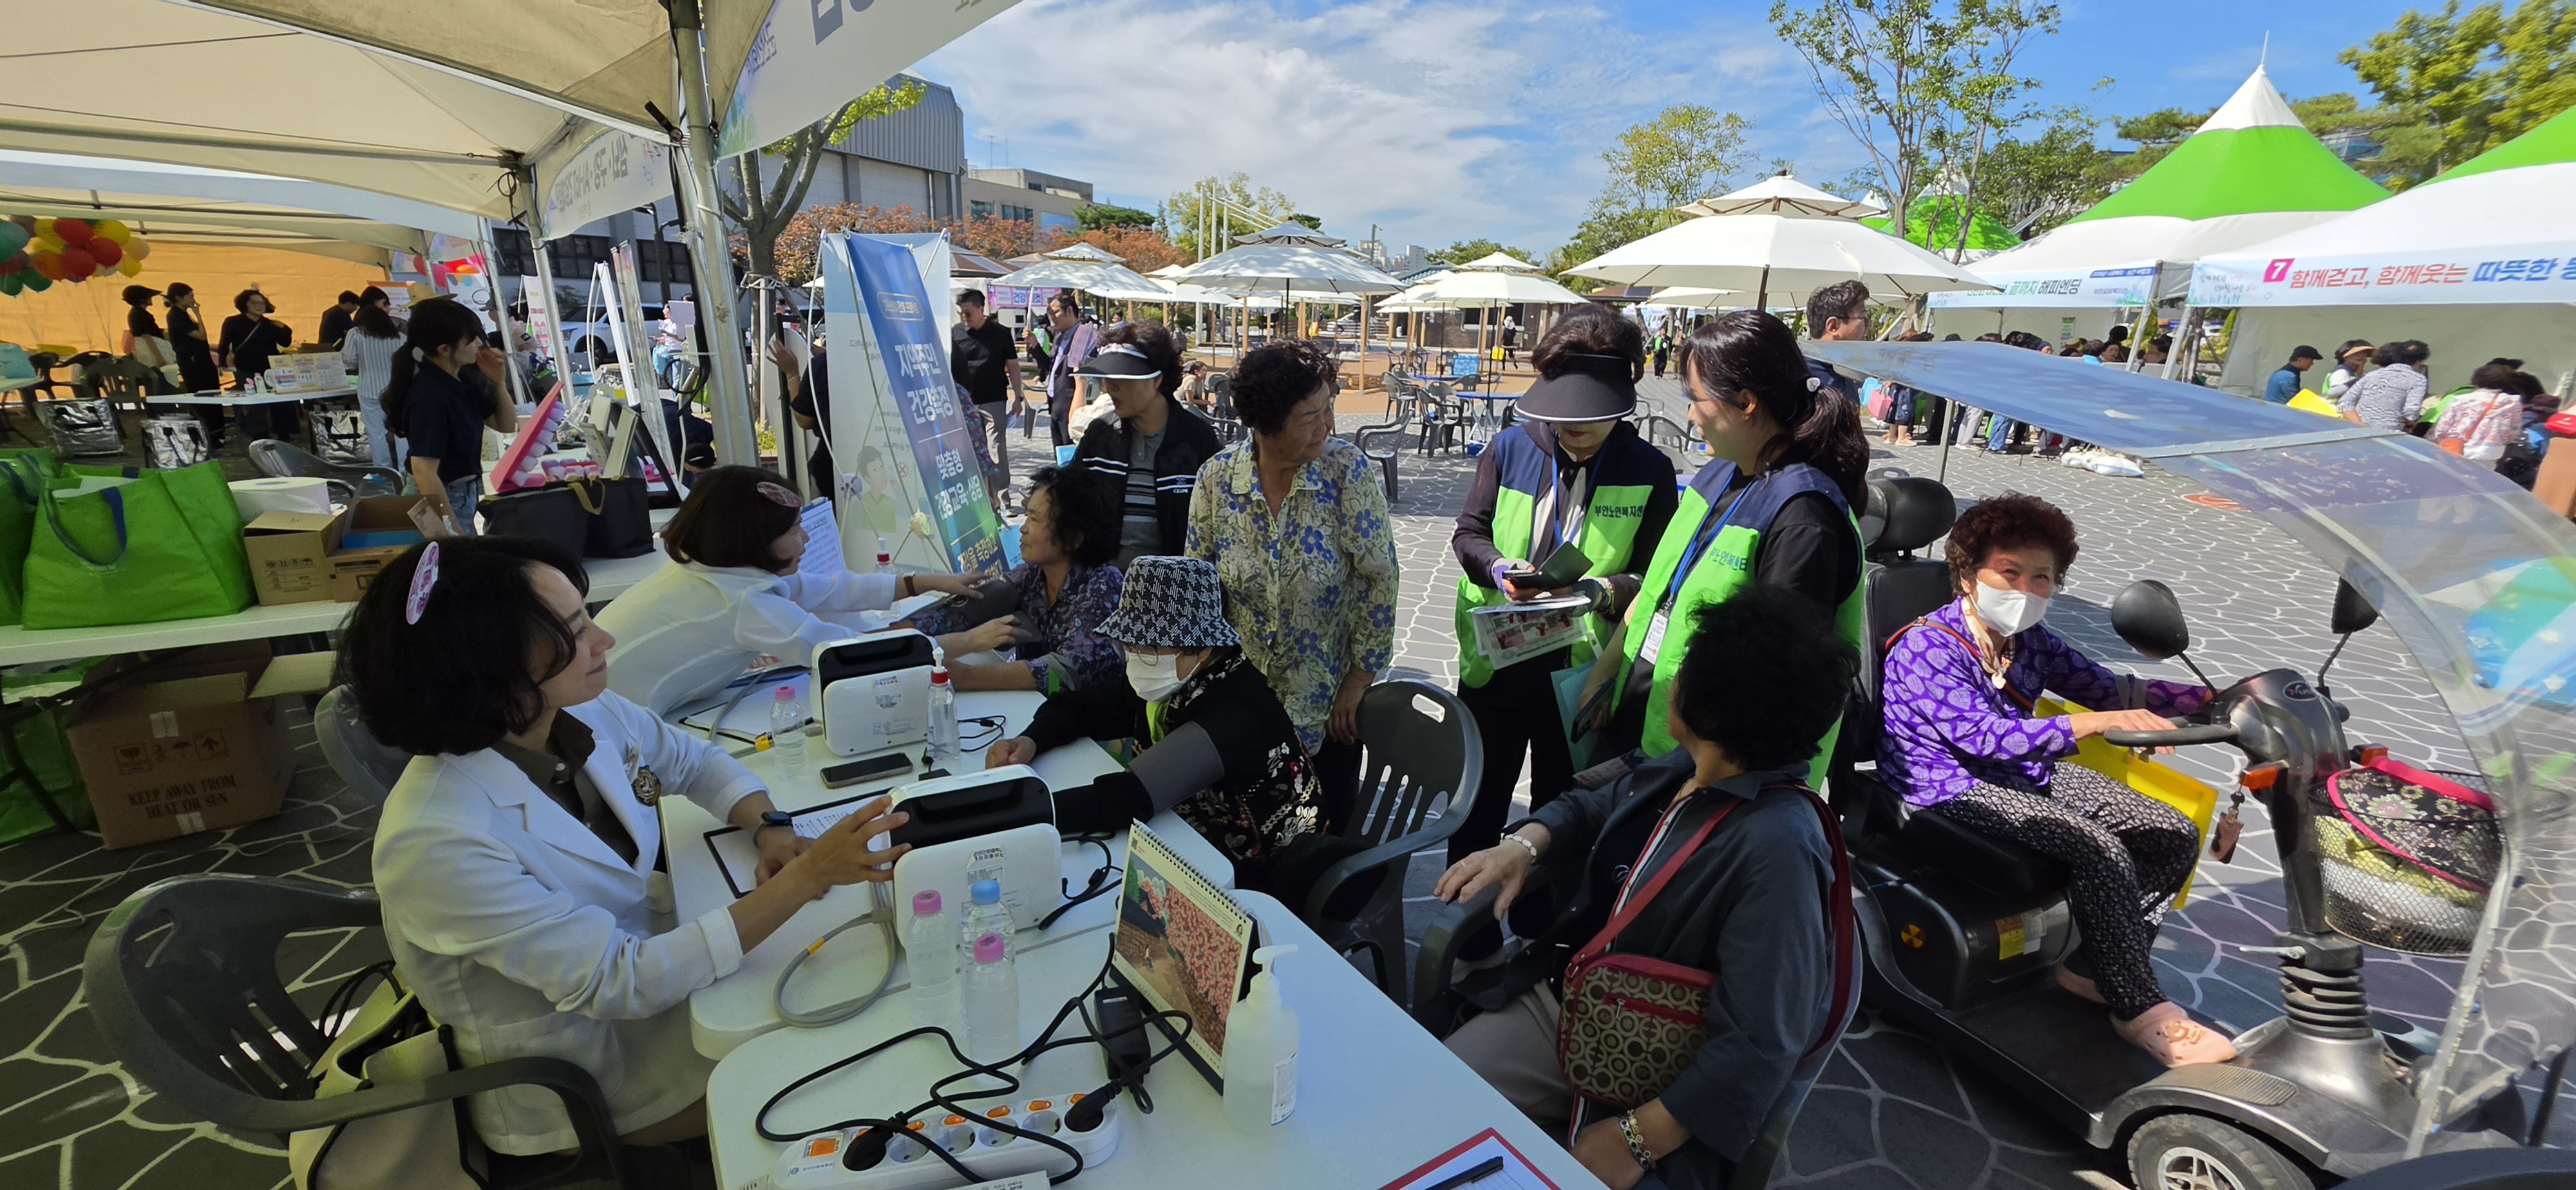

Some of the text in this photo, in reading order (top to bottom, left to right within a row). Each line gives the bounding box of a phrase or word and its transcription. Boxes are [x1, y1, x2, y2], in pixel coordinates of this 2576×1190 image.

[2009, 279, 2040, 296] 끝까지
[2038, 278, 2083, 295] 해피엔딩
[2271, 261, 2287, 279] 7
[2290, 267, 2369, 288] 함께걷고,
[2376, 263, 2469, 286] 함께웃는
[2472, 258, 2559, 283] 따뜻한
[895, 343, 942, 378] 지역주민
[907, 385, 953, 425] 건강측정
[935, 448, 964, 480] 맞춤형
[128, 775, 236, 806] KEEP AWAY FROM
[145, 793, 228, 819] HEAT OR SUN
